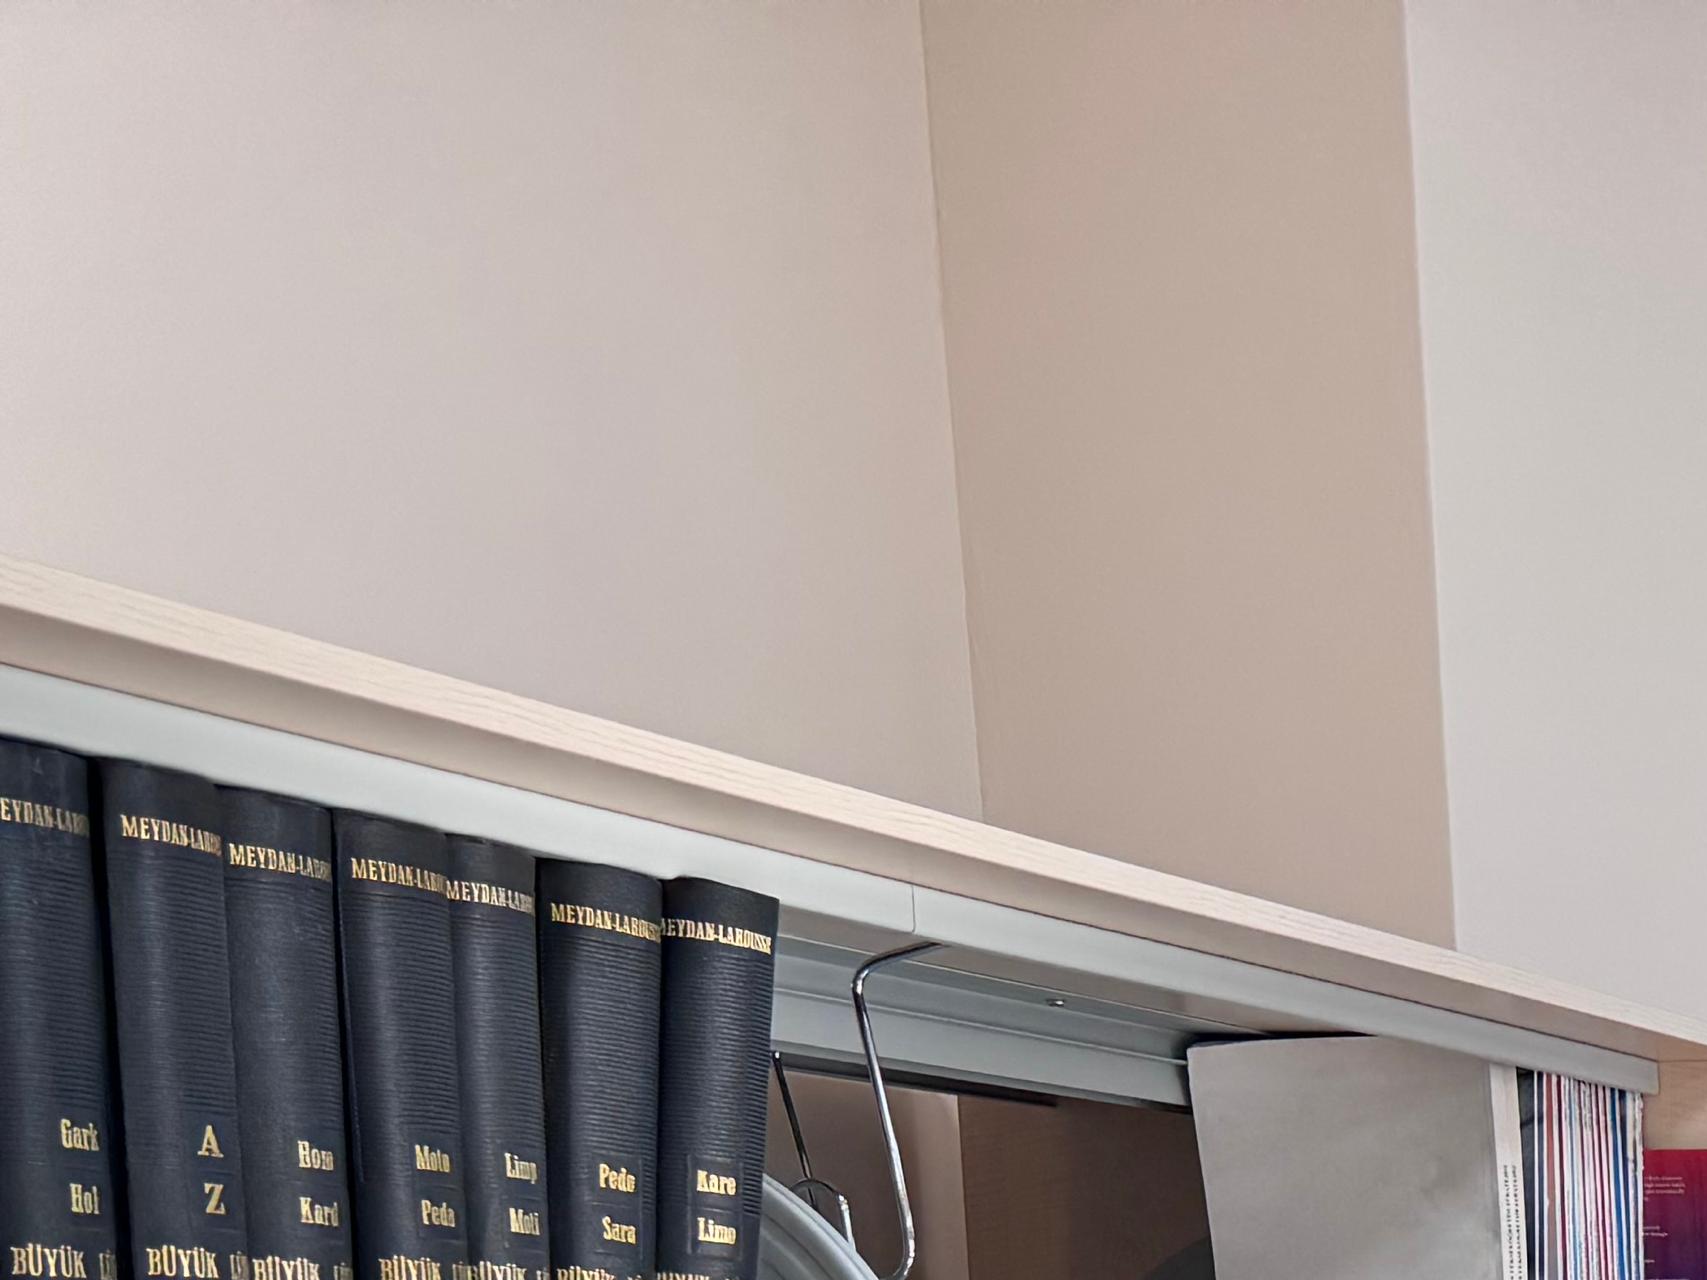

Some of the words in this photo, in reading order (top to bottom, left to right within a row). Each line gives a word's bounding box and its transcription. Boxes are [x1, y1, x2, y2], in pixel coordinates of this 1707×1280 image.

[197, 1124, 225, 1158] A
[203, 1182, 227, 1215] Z
[696, 1169, 737, 1196] Kare
[298, 1196, 340, 1228] Kard
[602, 1216, 637, 1245] Sara
[10, 1243, 87, 1279] BÜYÜK
[146, 1245, 220, 1279] BÜYÜK
